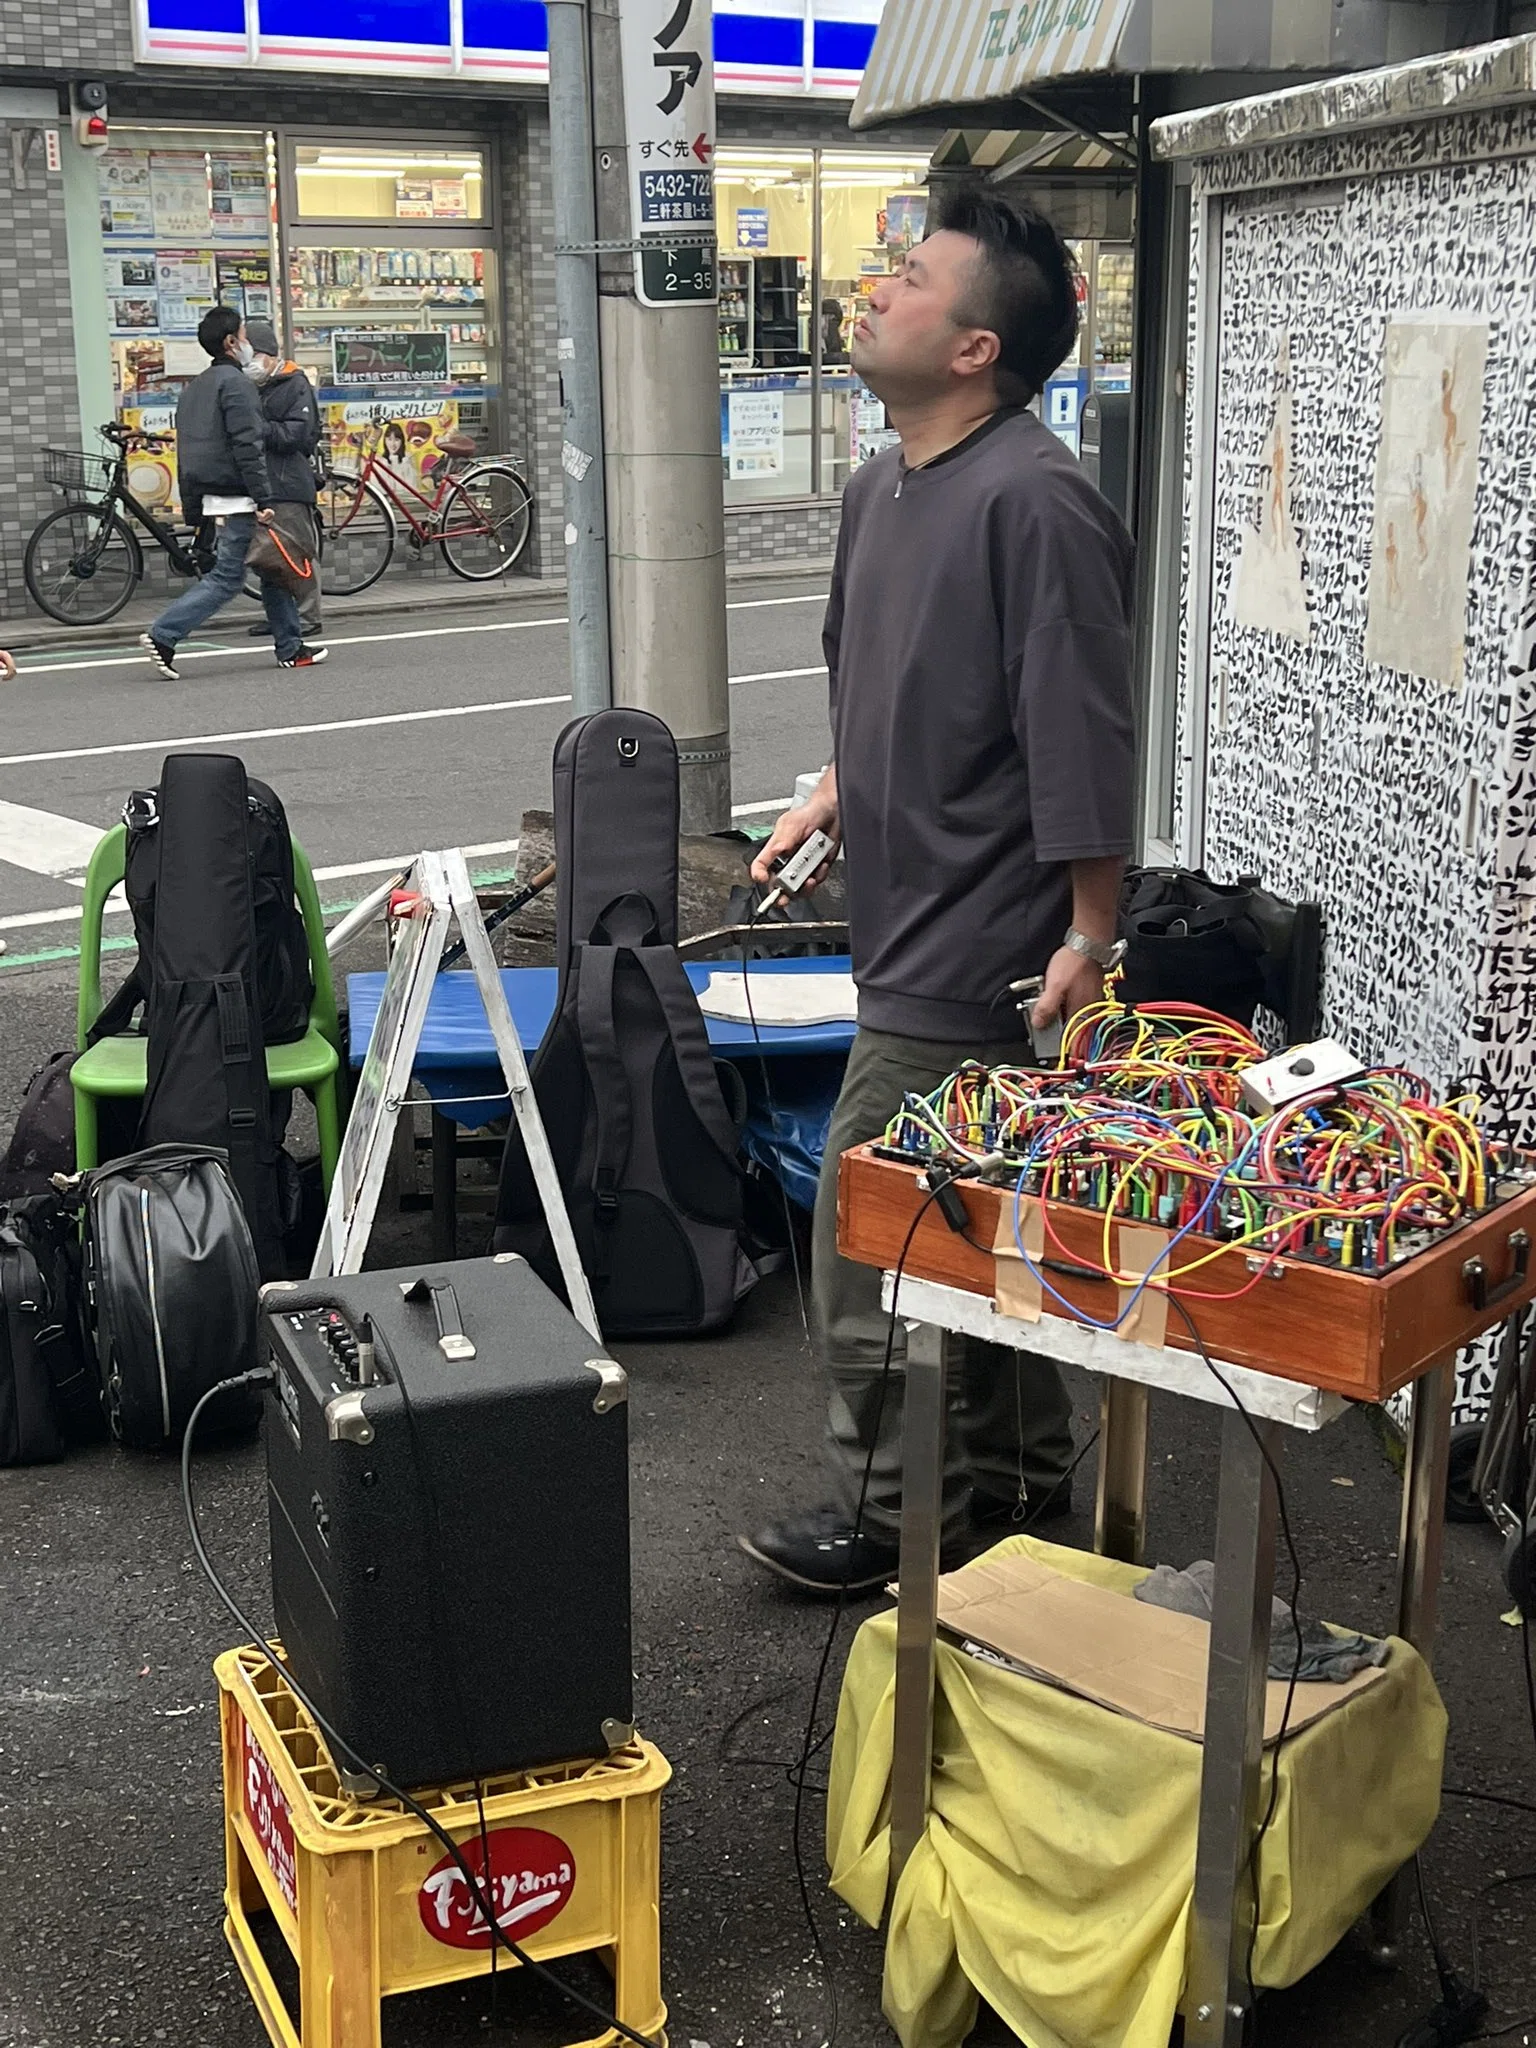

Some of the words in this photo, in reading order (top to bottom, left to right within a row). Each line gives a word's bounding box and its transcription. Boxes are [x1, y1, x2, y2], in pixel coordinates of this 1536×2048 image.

[638, 139, 690, 159] すぐ先
[665, 271, 712, 292] 2-35
